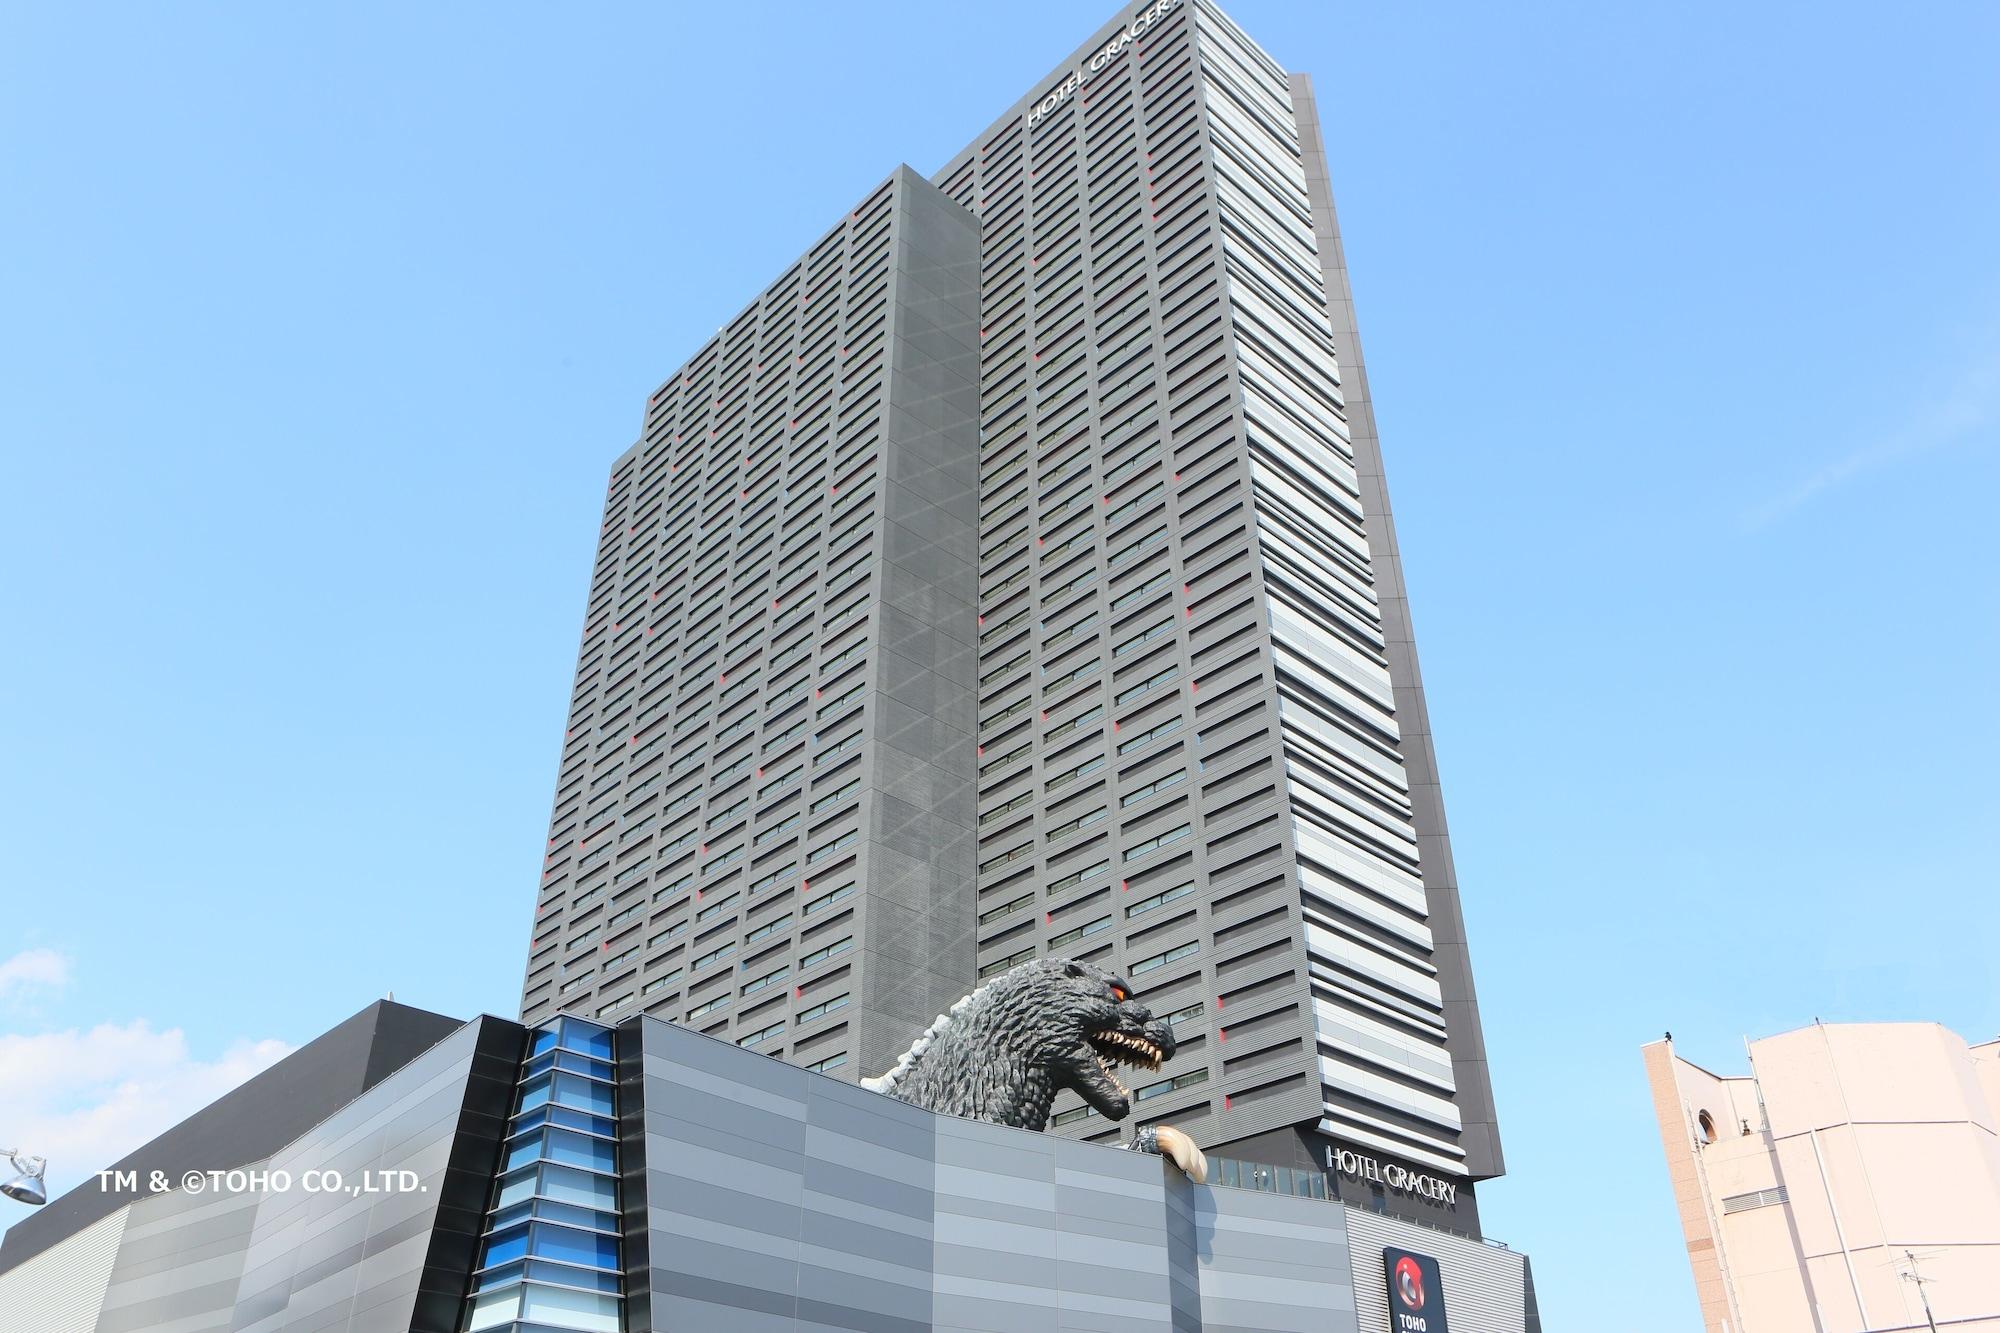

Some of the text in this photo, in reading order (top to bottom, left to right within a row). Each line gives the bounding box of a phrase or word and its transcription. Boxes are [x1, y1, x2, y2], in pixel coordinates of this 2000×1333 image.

[1027, 0, 1178, 128] HOTEL GRACER
[1325, 1145, 1457, 1205] HOTEL GRACERY
[1399, 1313, 1426, 1332] TOHO
